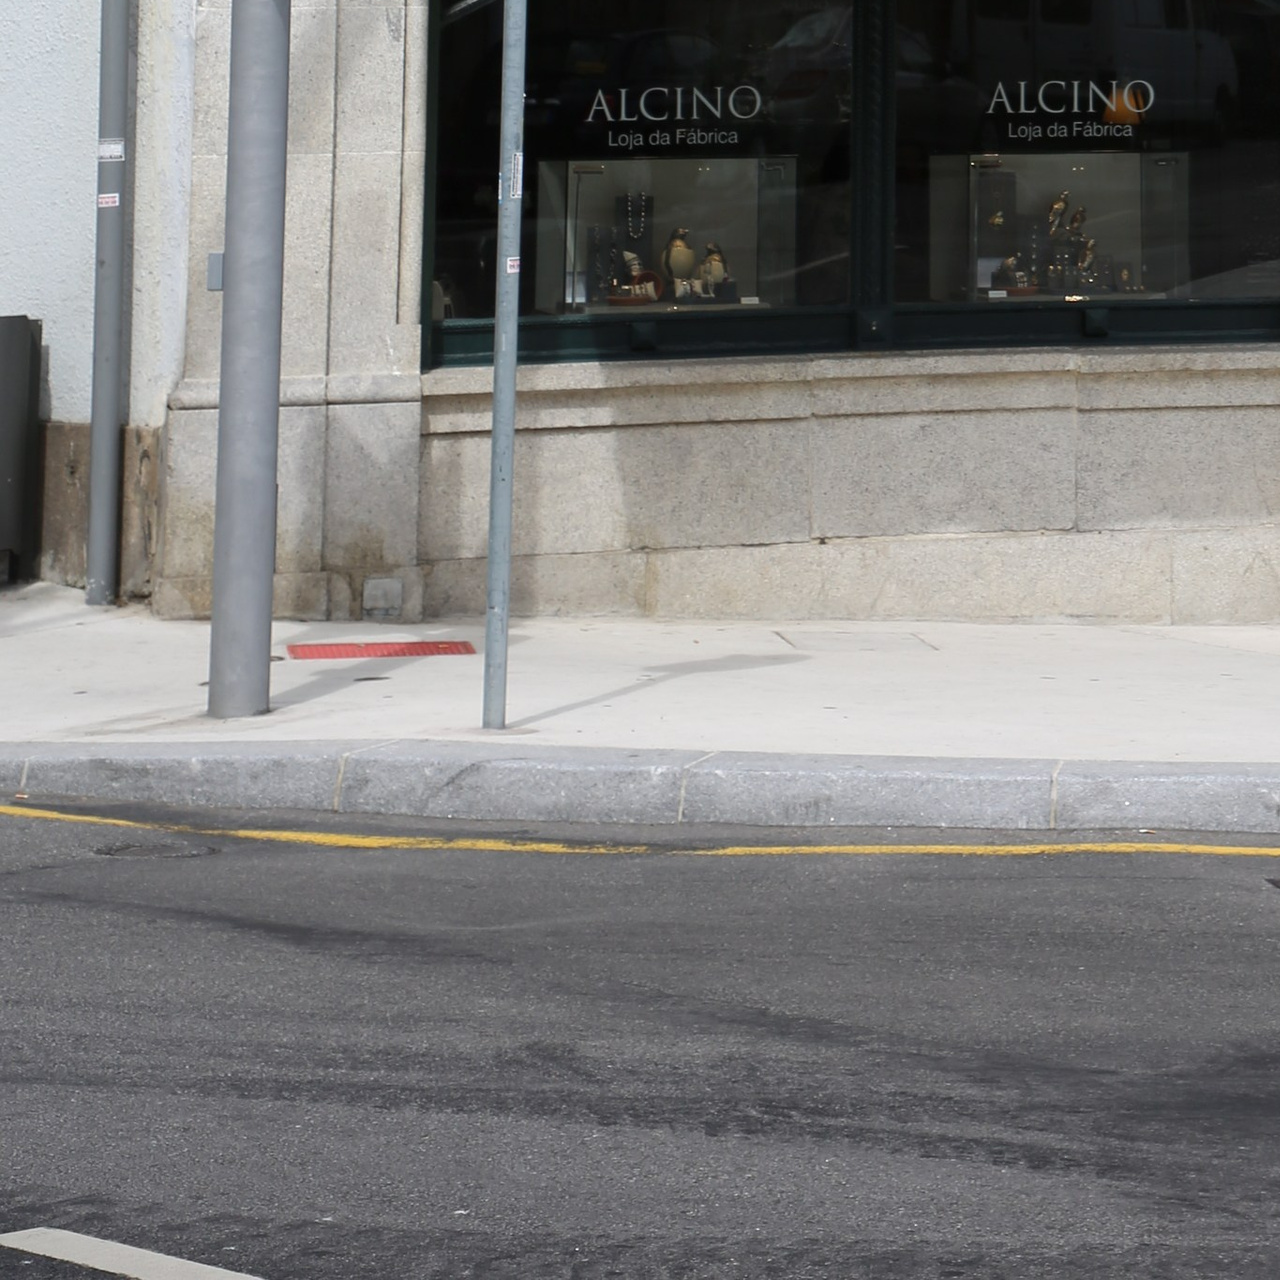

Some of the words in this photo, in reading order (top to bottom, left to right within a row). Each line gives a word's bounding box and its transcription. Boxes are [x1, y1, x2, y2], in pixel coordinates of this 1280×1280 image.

[585, 85, 762, 122] ALCINO
[986, 80, 1155, 114] ALCINO
[608, 129, 644, 149] Loja
[648, 129, 671, 146] da
[675, 128, 739, 145] Fábrica
[1008, 122, 1042, 141] Loja
[1047, 122, 1068, 138] da
[1073, 121, 1133, 138] Fábrica
